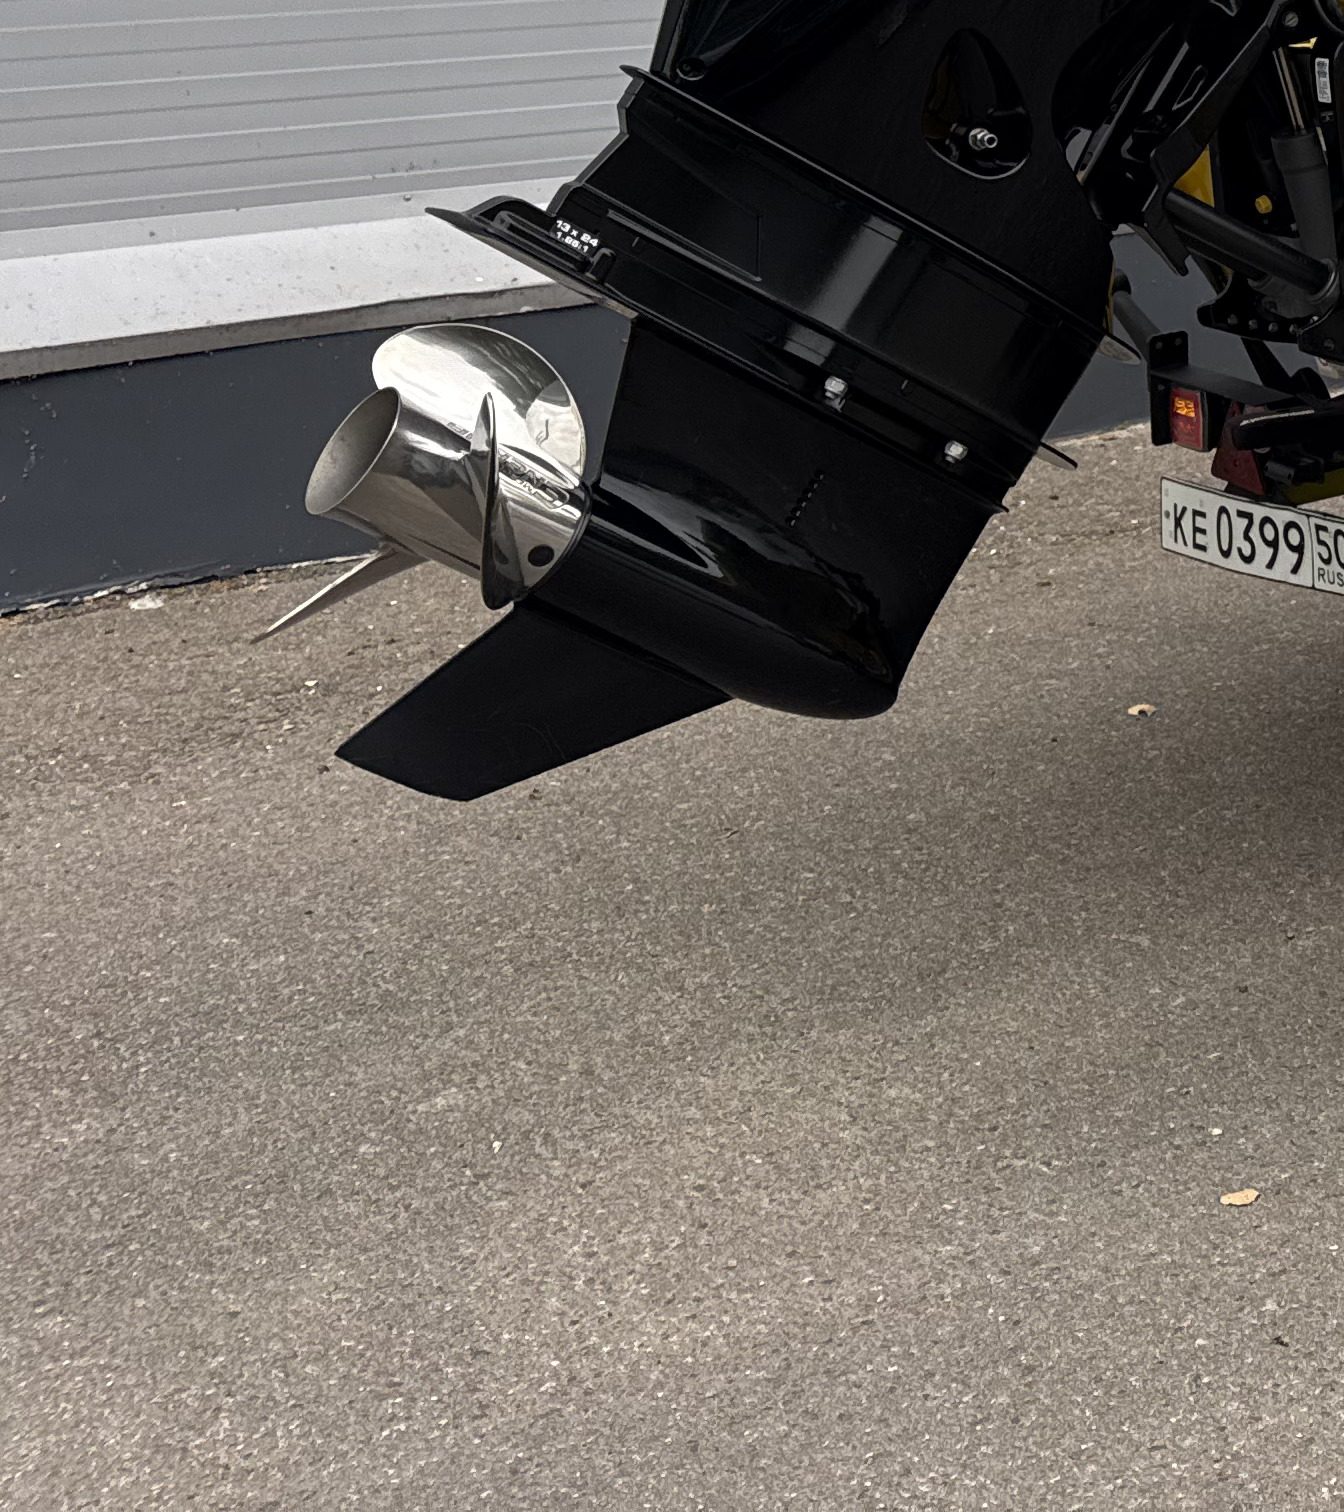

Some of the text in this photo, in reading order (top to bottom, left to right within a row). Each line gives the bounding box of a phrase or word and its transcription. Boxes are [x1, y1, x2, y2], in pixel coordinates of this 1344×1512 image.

[556, 219, 571, 233] 13
[580, 233, 598, 247] 24
[1317, 568, 1344, 587] RUS
